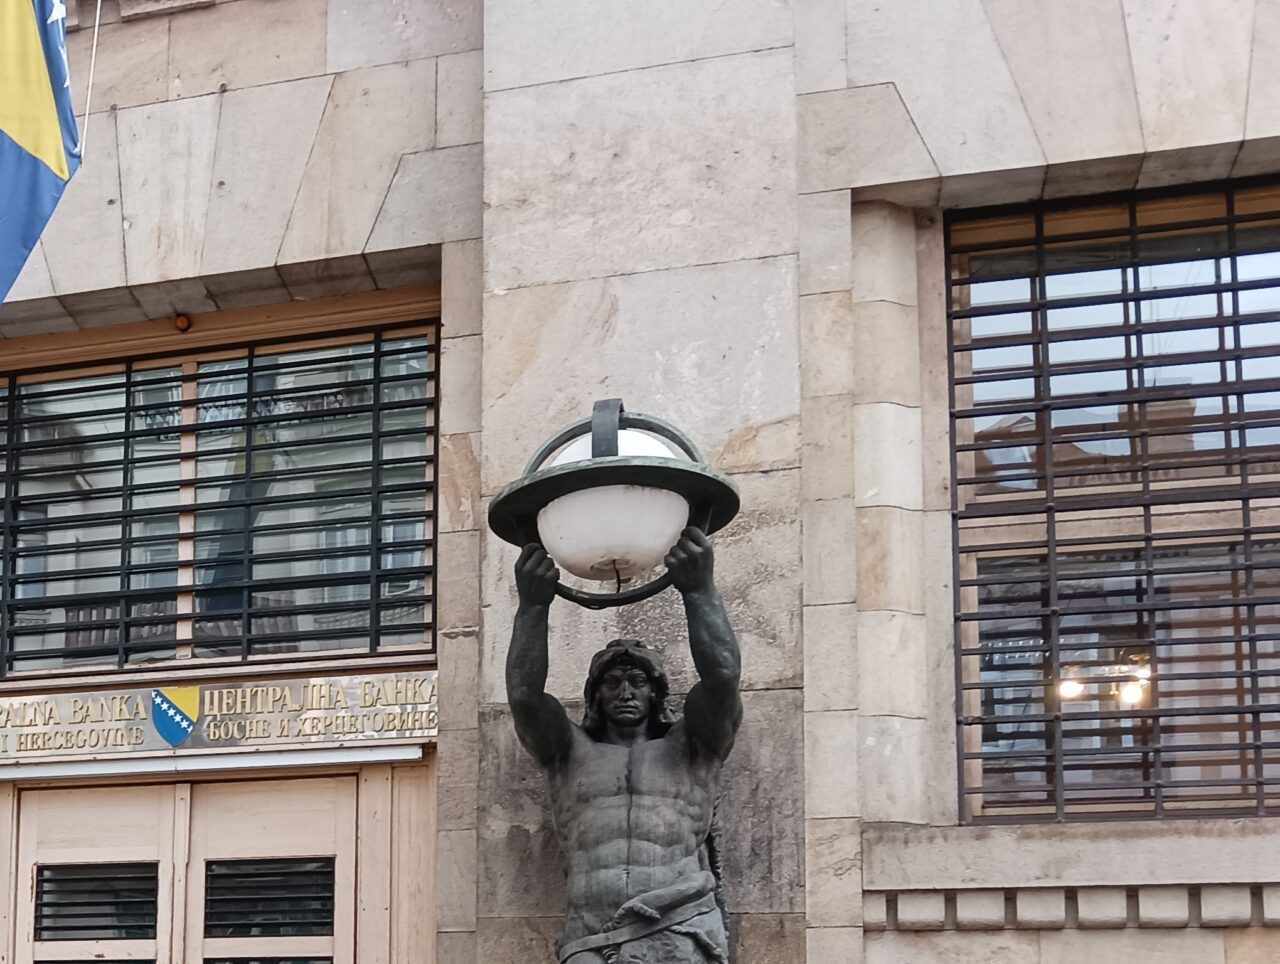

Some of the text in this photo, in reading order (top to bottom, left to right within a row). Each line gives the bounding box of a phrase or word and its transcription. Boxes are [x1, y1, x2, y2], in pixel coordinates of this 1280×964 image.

[69, 694, 147, 724] BANKA
[204, 682, 349, 719] ЦЕНТРАЛНА
[1, 734, 9, 753] I
[16, 726, 145, 752] HERCEGOVINE
[209, 710, 438, 741] БОСНЕ И ХЕРЦЕГОВИНЕ
